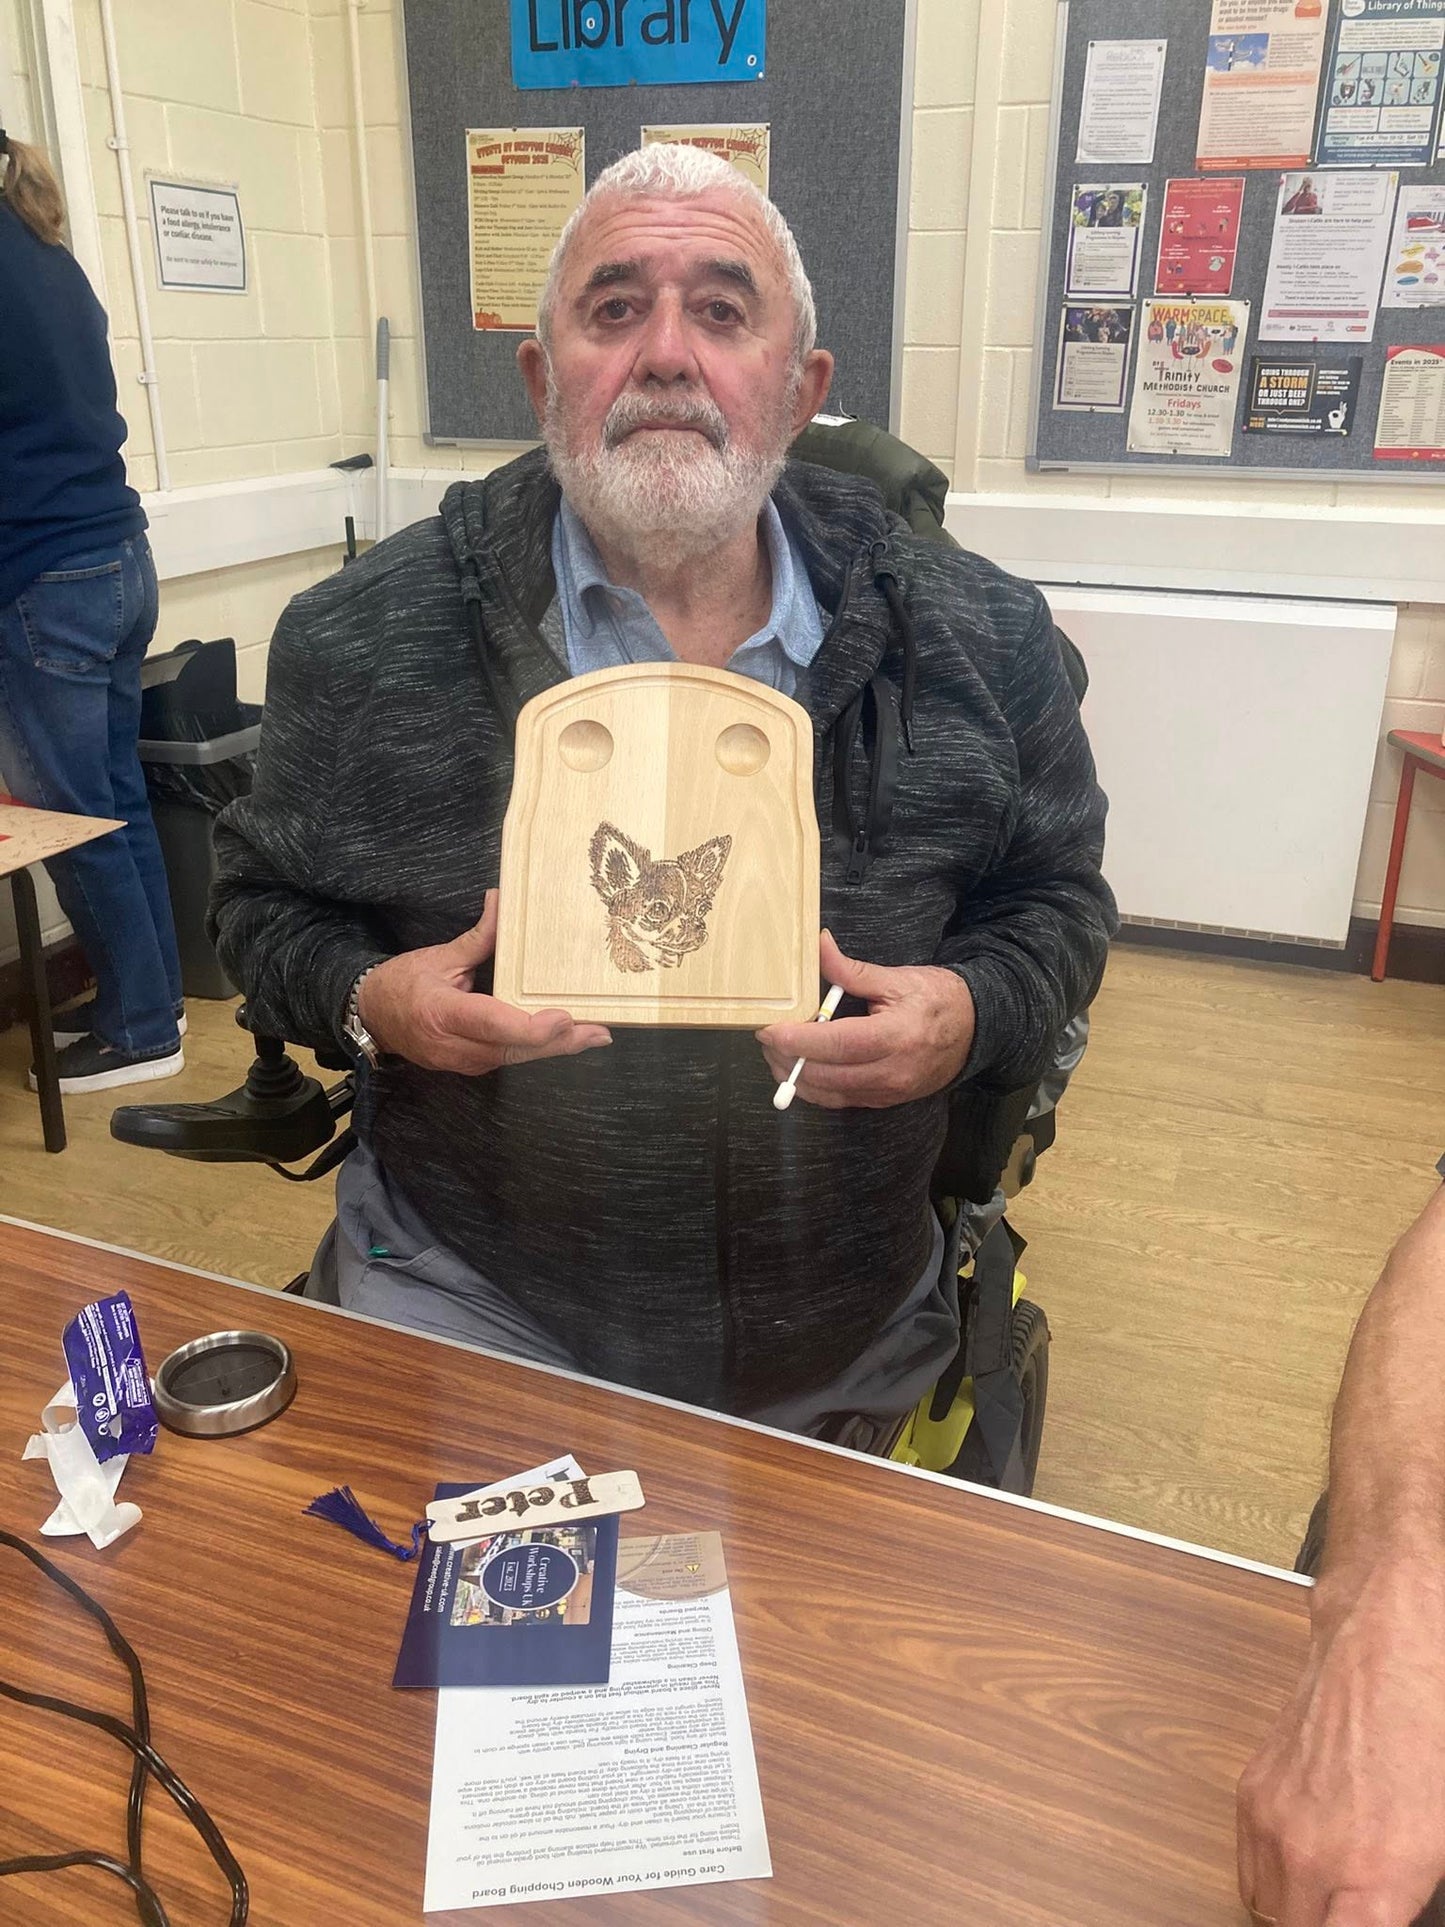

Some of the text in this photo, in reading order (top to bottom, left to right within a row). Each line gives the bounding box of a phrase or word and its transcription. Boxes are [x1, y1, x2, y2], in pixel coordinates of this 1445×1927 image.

[1368, 0, 1400, 12] Library
[1404, 0, 1414, 10] of
[528, 0, 744, 65] Library
[160, 206, 180, 216] Please
[180, 208, 190, 217] talk
[192, 210, 198, 218] to
[210, 213, 220, 222] you
[220, 213, 234, 222] have
[167, 218, 180, 226] food
[202, 222, 231, 232] intolerance
[1260, 376, 1308, 389] A STORM
[1196, 384, 1230, 393] CHURCH
[1258, 389, 1268, 398] OR
[1269, 389, 1288, 398] JUST
[1167, 398, 1202, 410] Fridays
[1147, 408, 1185, 417] 12.30-1.30
[454, 1478, 600, 1522] Peter
[504, 1562, 516, 1591] Est. 2023
[521, 1547, 540, 1606] Workshops UK
[536, 1556, 551, 1594] Creative
[666, 1659, 717, 1670] Deep Cleaning
[665, 1742, 698, 1752] Cleaning
[698, 1739, 728, 1748] Regular
[623, 1746, 649, 1755] Drying
[599, 1839, 615, 1847] help
[715, 1844, 742, 1853] Before
[512, 1854, 533, 1862] grade
[566, 1848, 593, 1857] treating
[471, 1864, 725, 1899] Care Guide for Your Wooden Chopping Board
